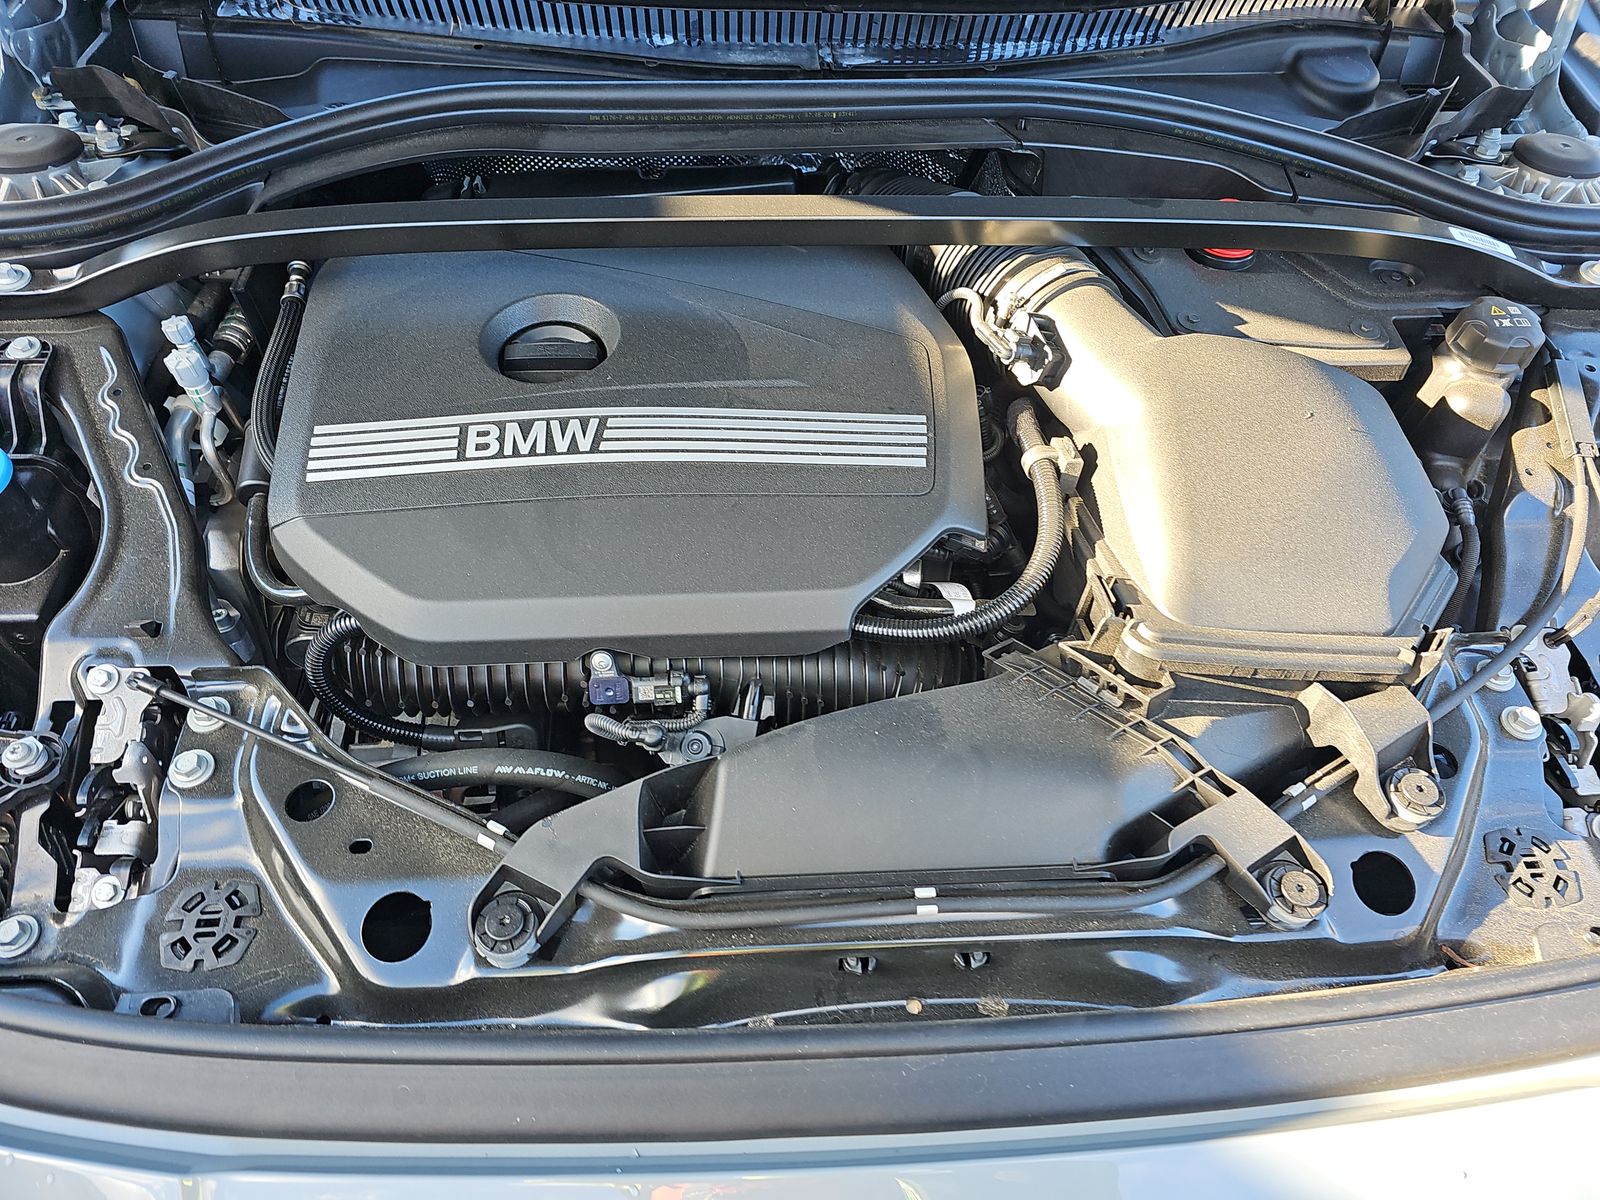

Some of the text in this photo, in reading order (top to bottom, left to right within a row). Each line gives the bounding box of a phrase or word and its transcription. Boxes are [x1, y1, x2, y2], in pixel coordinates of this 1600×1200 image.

[465, 417, 600, 459] BMW
[417, 768, 457, 781] SUCTION
[458, 765, 479, 775] LINE
